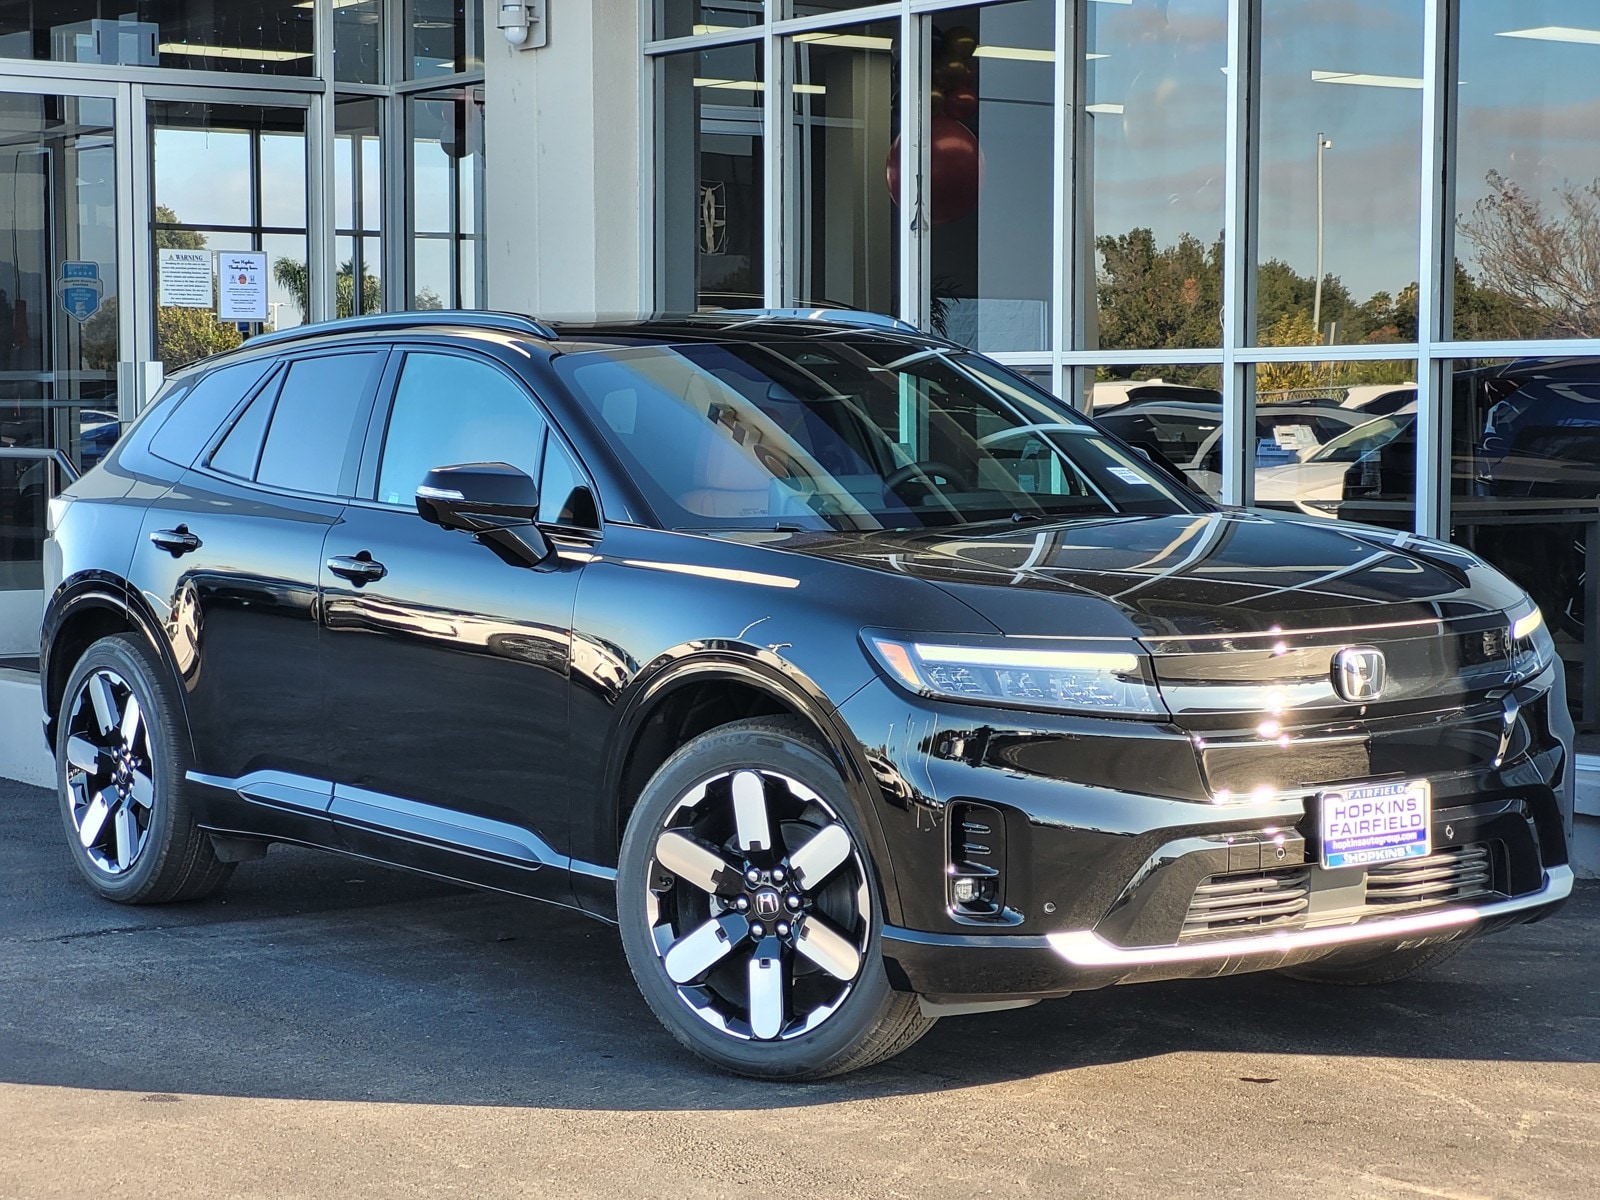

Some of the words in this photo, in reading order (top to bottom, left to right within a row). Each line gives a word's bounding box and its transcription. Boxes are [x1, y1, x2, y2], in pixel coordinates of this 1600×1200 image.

[1348, 785, 1405, 800] FAIRFIELD
[1335, 798, 1417, 820] HOPKINS
[1330, 814, 1422, 837] FAIRFIELD
[1332, 831, 1418, 851] hopkinsautogroup.com
